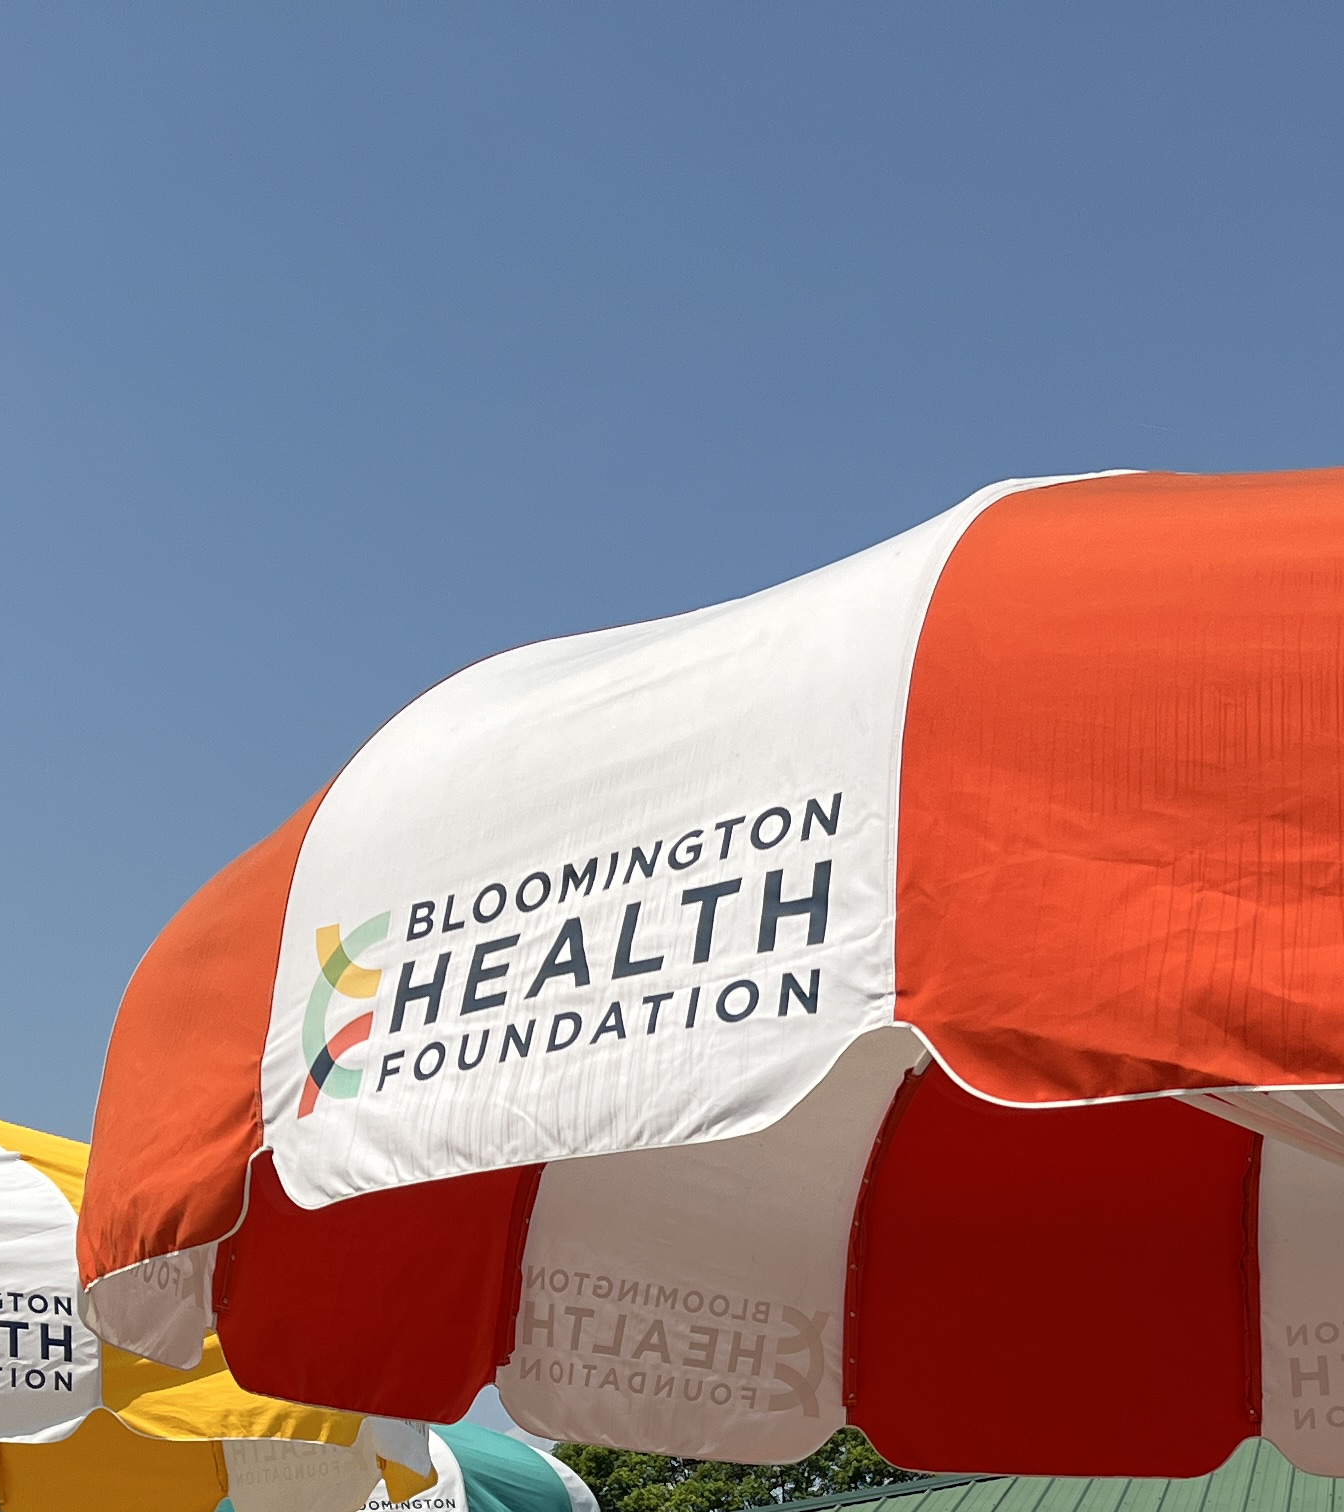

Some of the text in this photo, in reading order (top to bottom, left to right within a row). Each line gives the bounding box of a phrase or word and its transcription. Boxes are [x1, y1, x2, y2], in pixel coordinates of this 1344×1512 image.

[406, 792, 843, 942] BLOOMINGTON
[389, 859, 833, 1033] HEALTH
[376, 968, 821, 1092] FOUNDATION
